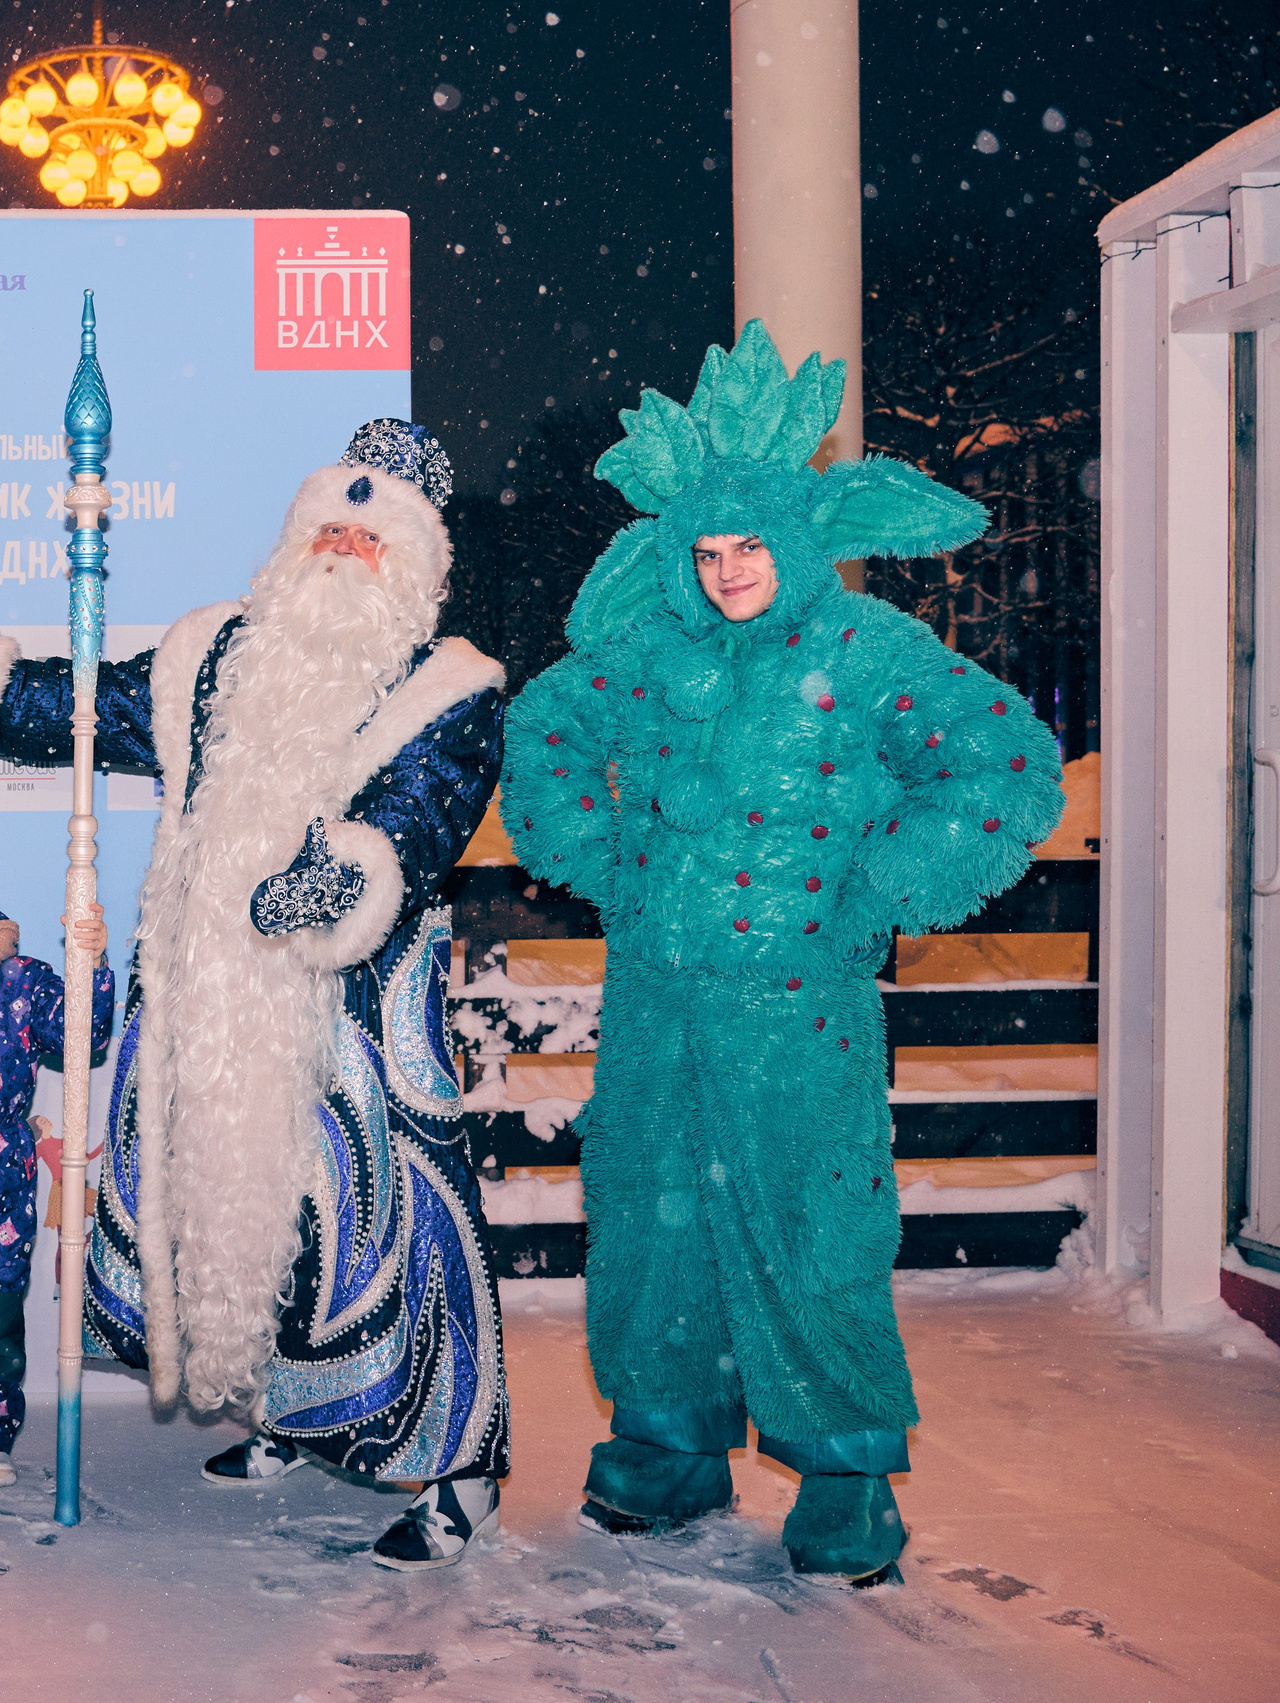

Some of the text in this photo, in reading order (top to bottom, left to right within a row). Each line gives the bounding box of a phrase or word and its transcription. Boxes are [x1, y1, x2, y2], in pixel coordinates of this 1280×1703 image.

[277, 320, 389, 349] ВДНХ
[46, 481, 176, 520] ЖЗНИ
[6, 782, 35, 791] МОСКВА
